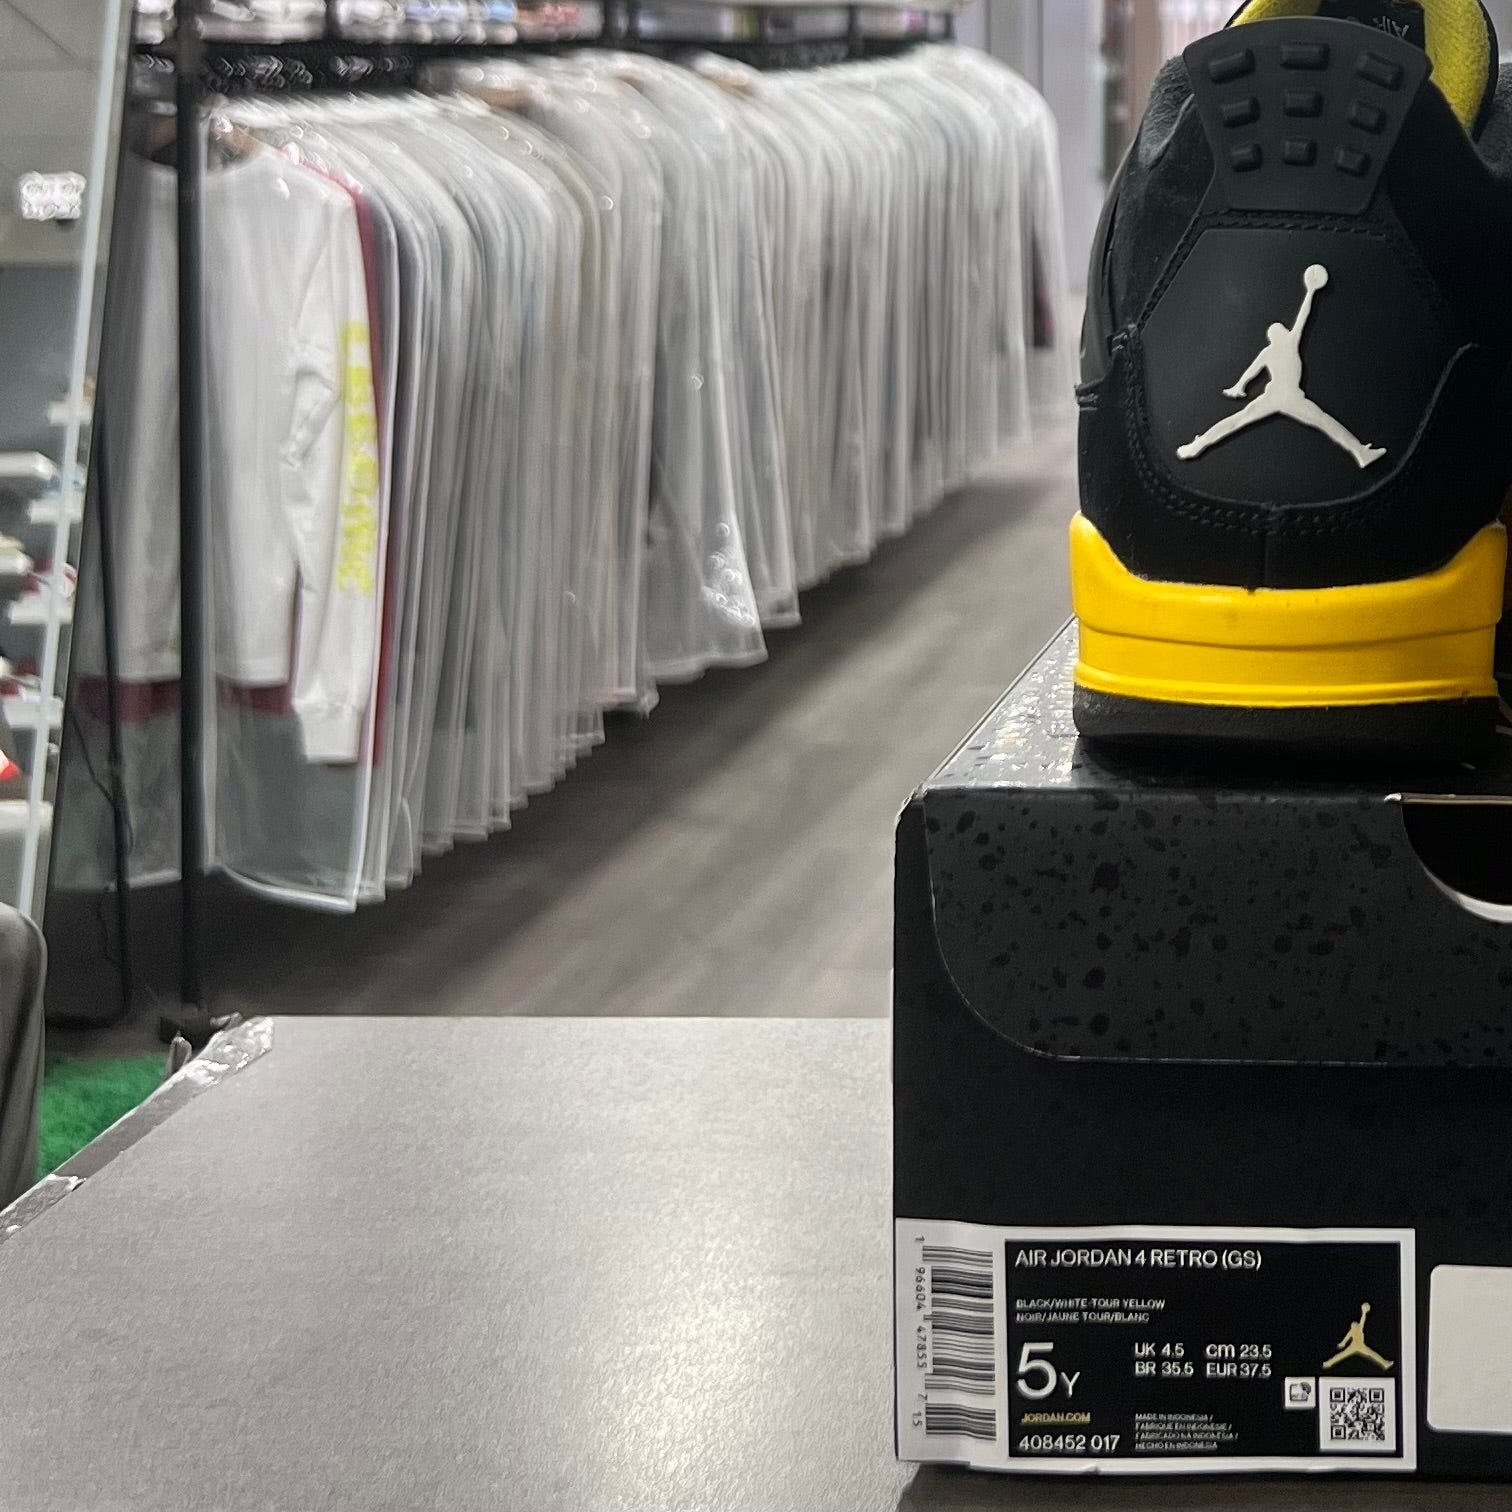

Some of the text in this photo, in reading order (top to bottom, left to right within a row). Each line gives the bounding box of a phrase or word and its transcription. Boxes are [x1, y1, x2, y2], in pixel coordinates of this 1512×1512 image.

[1015, 1249, 1262, 1271] AIR JORDAN 4 RETRO (GS)
[915, 1267, 926, 1311] 96604
[1122, 1299, 1166, 1311] YELLOW
[1016, 1312, 1080, 1323] NOIR/JAUNE
[916, 1326, 928, 1368] 47855
[1134, 1342, 1156, 1357] UK
[1161, 1343, 1185, 1357] 4.5
[1240, 1344, 1272, 1358] 23.5
[1134, 1361, 1272, 1377] BR 35.5 EUR 37.5
[1020, 1413, 1091, 1425] JORDAN.COM
[1019, 1435, 1121, 1451] 408452 017
